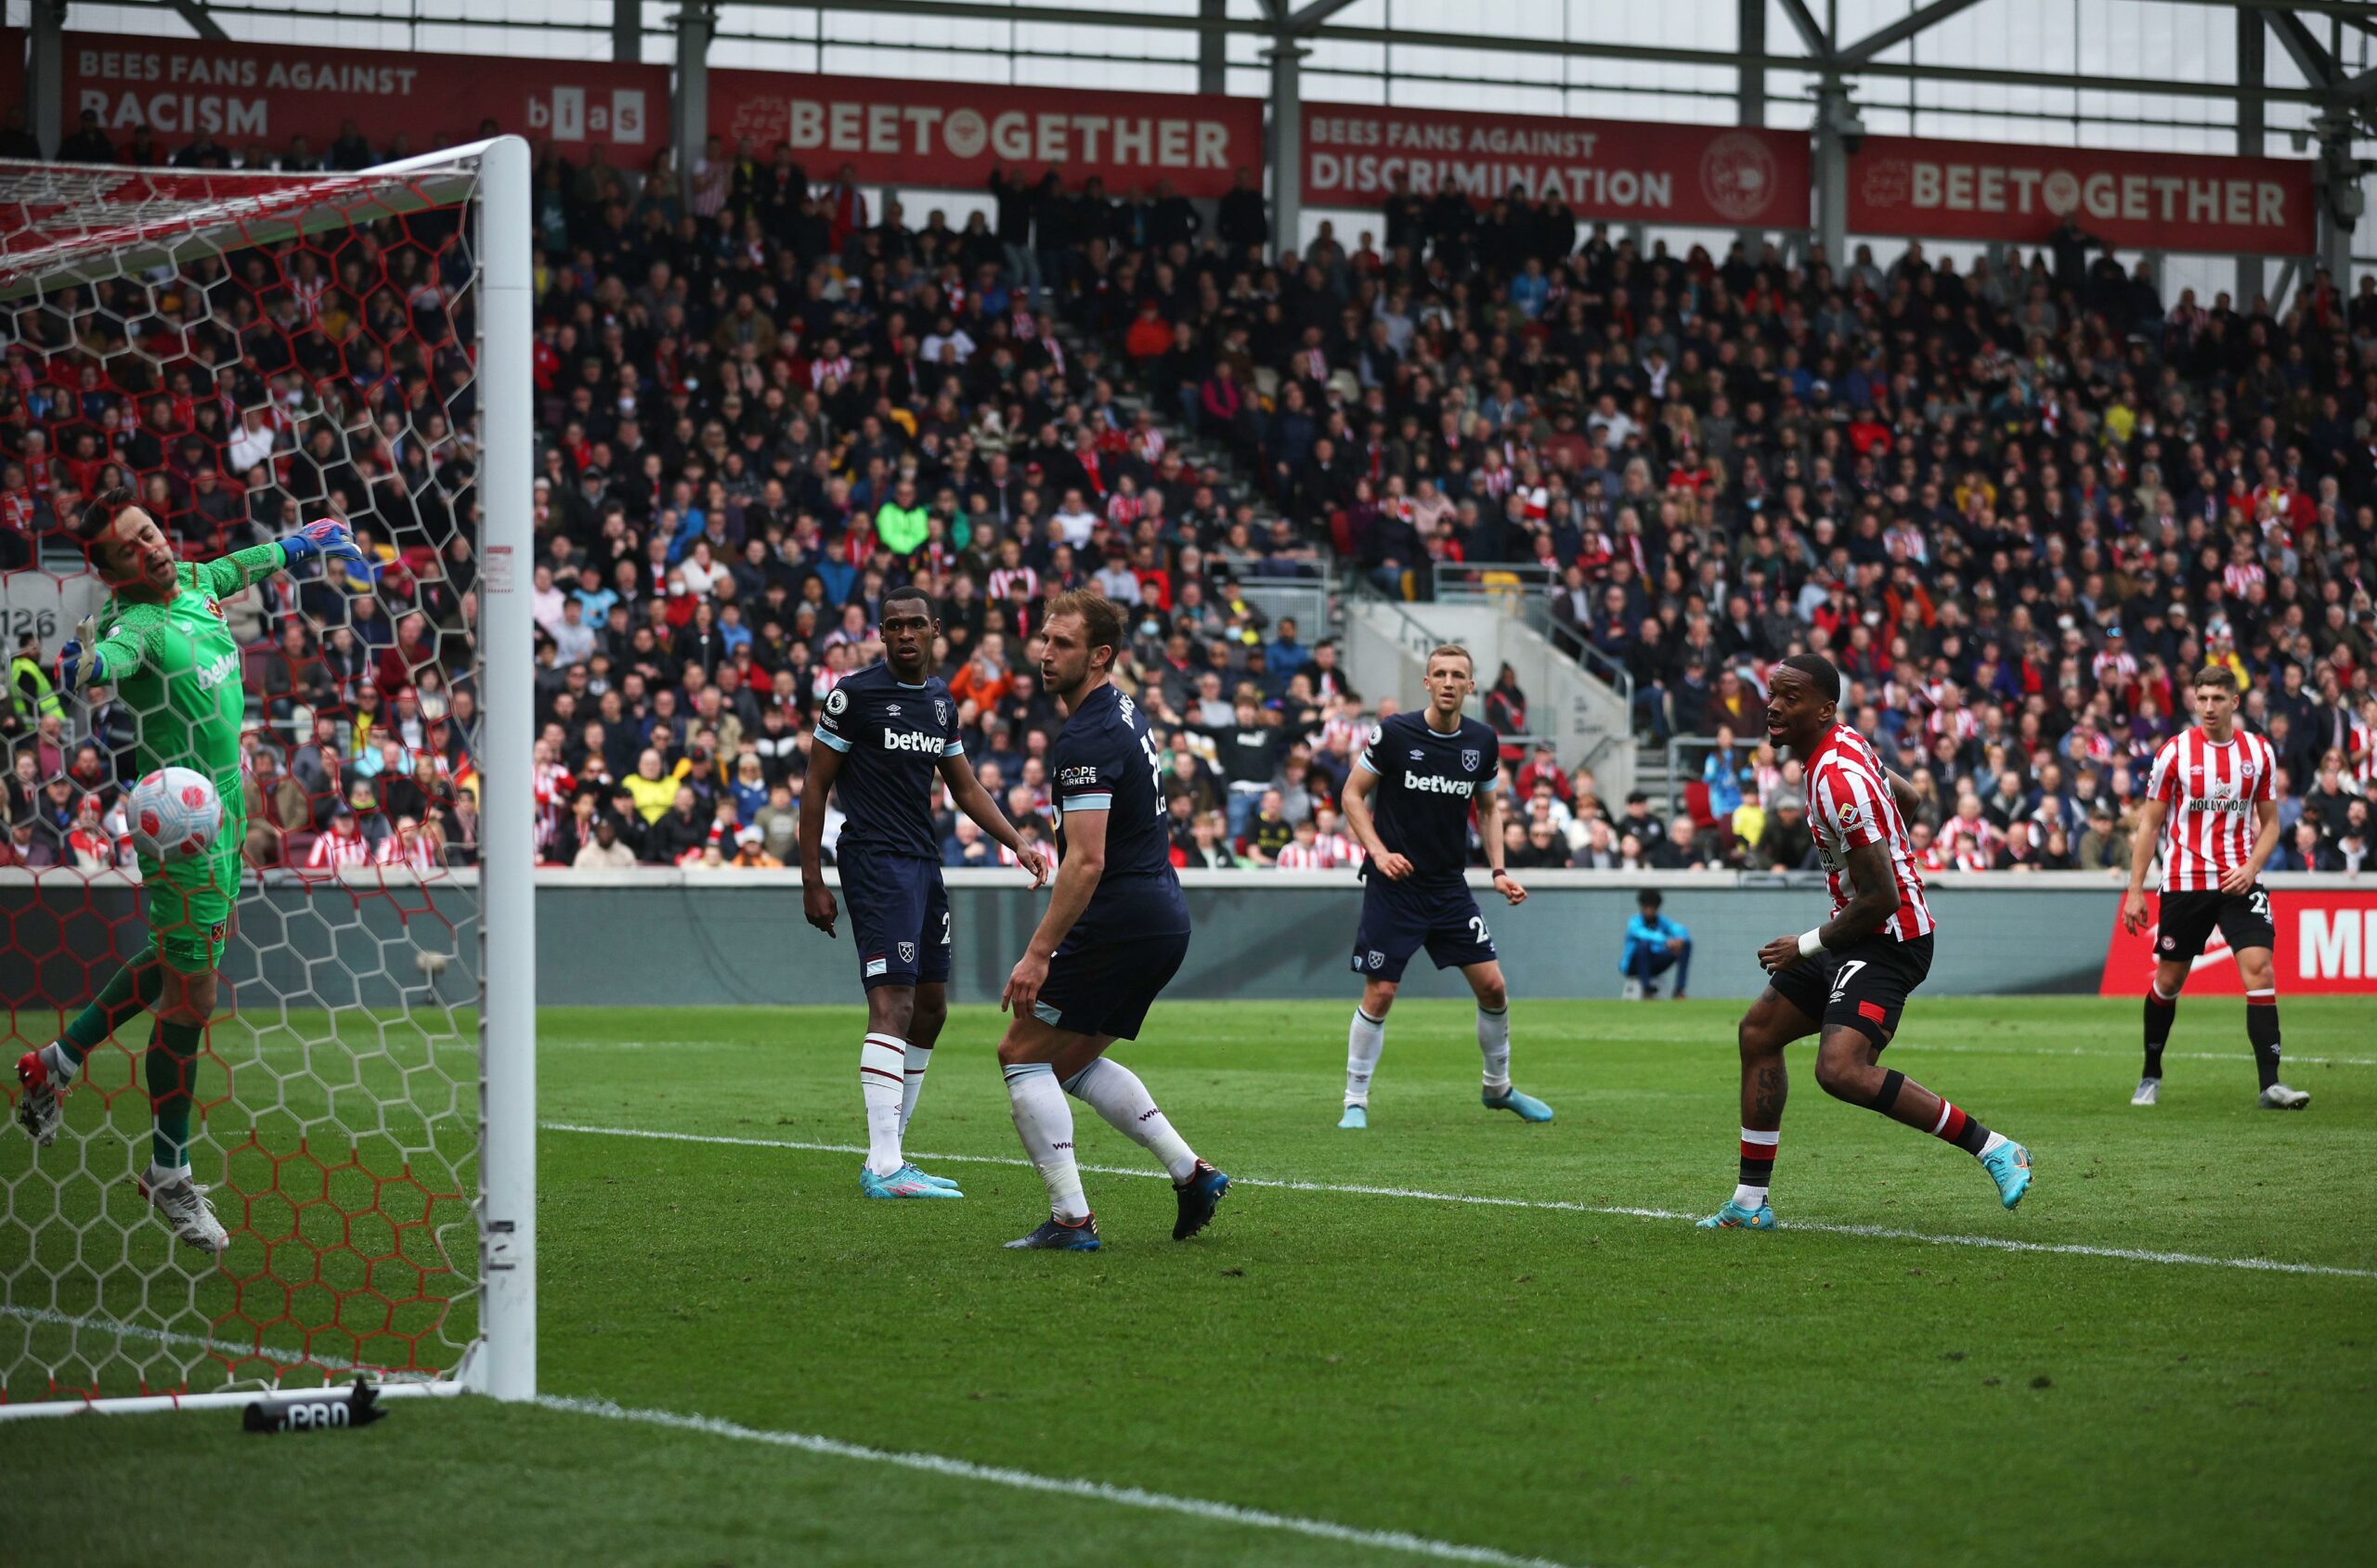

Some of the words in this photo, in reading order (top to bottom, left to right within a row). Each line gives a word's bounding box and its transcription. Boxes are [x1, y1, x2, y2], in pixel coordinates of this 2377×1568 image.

[79, 50, 161, 82] BEES
[170, 55, 258, 87] FANS
[266, 60, 417, 97] AGAINST
[80, 89, 268, 137] RACISM
[527, 95, 639, 132] bias
[1310, 117, 1380, 146] BEES
[1387, 123, 1461, 151] FANS
[1470, 127, 1599, 159] AGAINST
[1310, 154, 1672, 208] DISCRIMINATION
[0, 608, 56, 639] 126
[884, 727, 946, 758] betway
[1060, 766, 1097, 780] SCOPE
[1404, 770, 1475, 799] betway
[1831, 960, 1867, 991] 17
